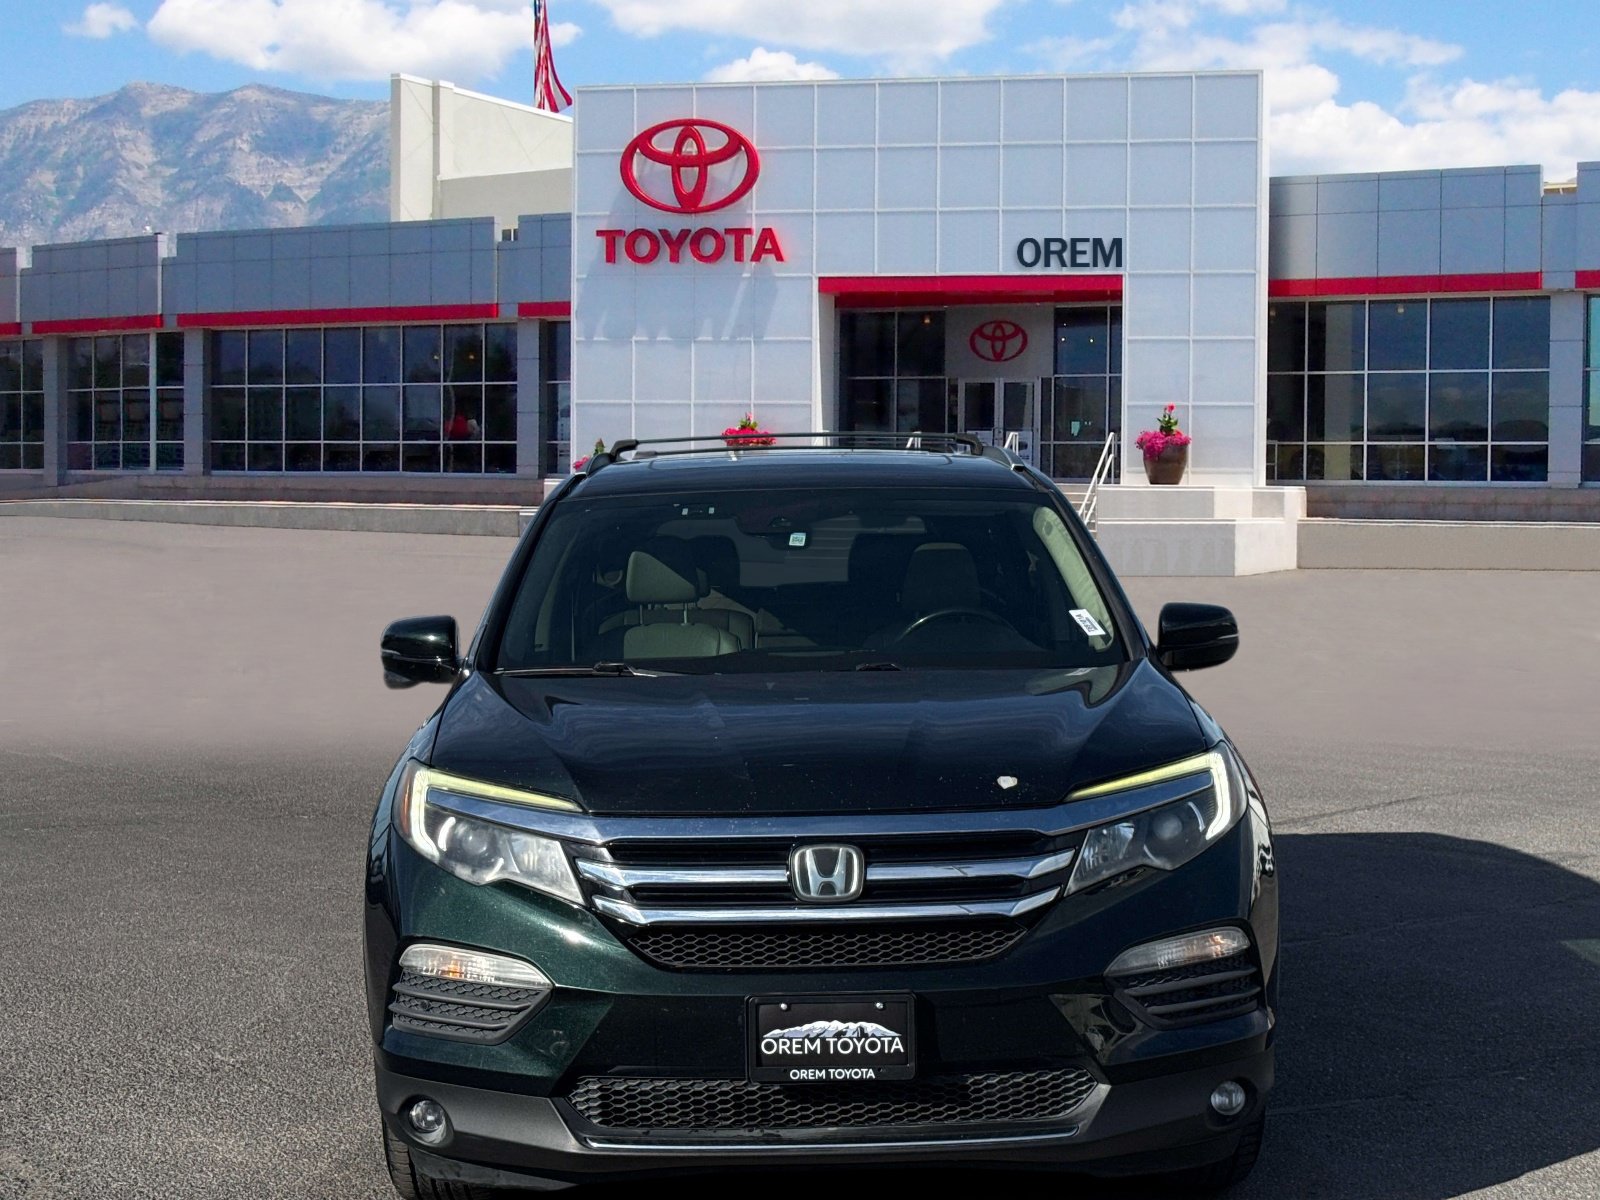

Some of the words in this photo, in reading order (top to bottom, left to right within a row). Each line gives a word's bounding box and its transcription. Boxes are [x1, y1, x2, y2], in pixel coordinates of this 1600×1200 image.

[596, 227, 784, 264] TOYOTA
[1017, 237, 1122, 268] OREM
[761, 1038, 821, 1055] OREM
[826, 1037, 905, 1054] TOYOTA
[790, 1069, 825, 1080] OREM
[829, 1069, 876, 1080] TOYOTA
